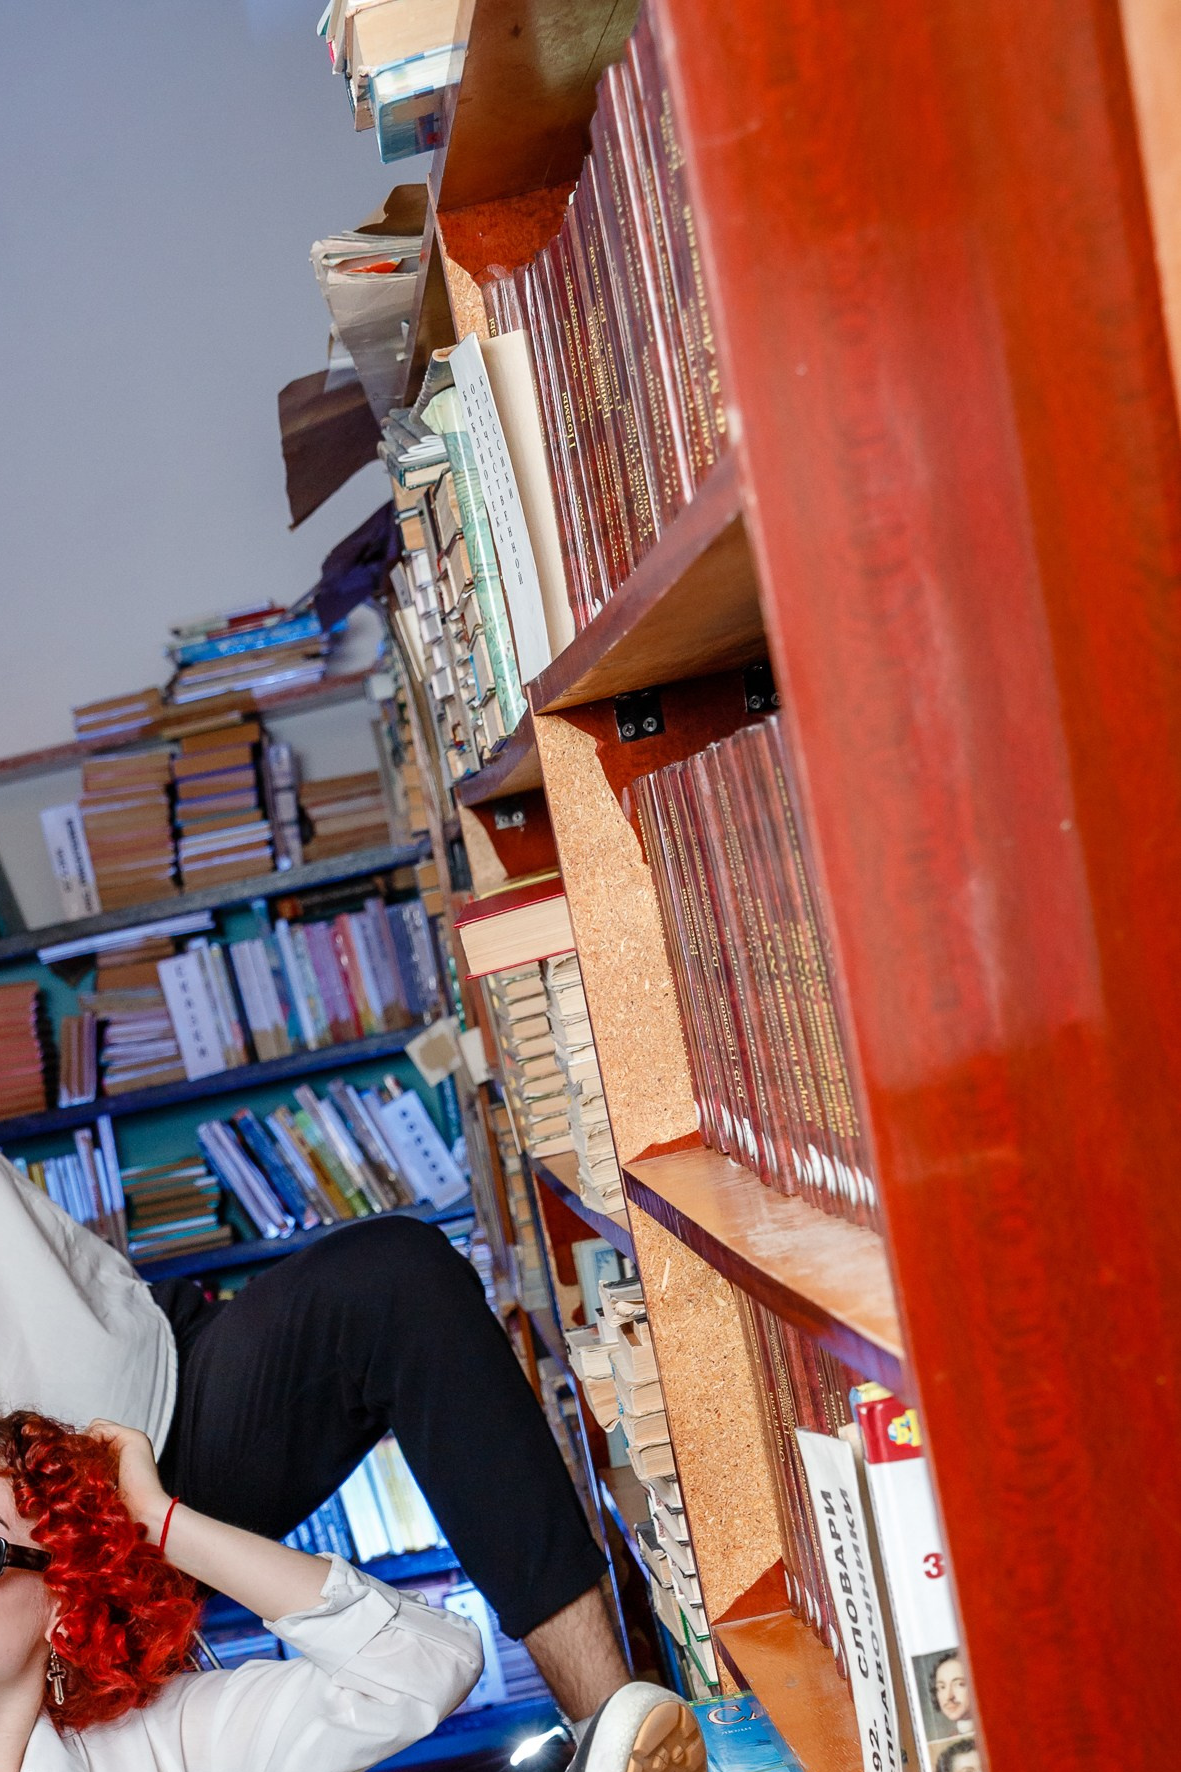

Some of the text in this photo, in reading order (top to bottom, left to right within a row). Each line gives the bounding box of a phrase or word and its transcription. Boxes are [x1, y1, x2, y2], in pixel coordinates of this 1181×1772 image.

[678, 204, 728, 434] Ф. М. Достоевский
[462, 390, 504, 544] БИБЛИОТЕКА
[478, 374, 514, 500] КЛАССИКИ
[556, 390, 579, 448] Поэмы
[717, 996, 744, 1098] В.В. Набоков
[767, 1391, 778, 1417] дети
[774, 1429, 786, 1462] Отцы
[820, 1488, 871, 1682] СЛОВАРИ
